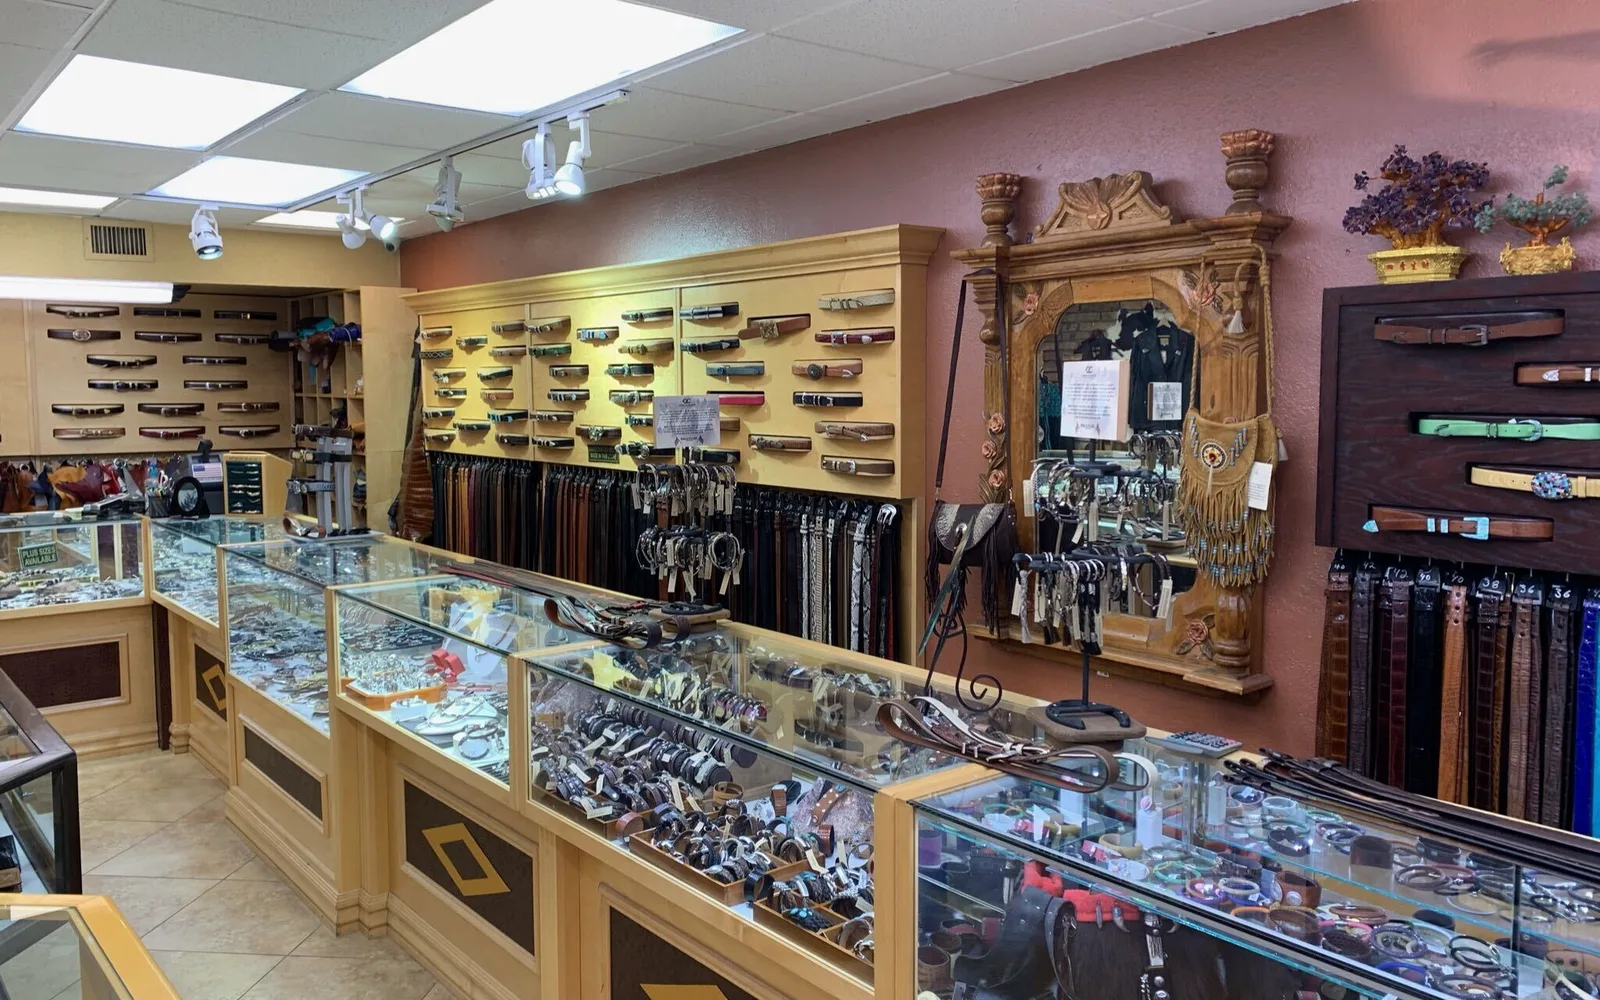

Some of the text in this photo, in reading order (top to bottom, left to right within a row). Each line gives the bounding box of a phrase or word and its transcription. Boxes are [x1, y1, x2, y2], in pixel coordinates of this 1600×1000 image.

[22, 546, 56, 558] PLUS SIZES
[24, 554, 56, 566] AVAILABLE
[1363, 561, 1376, 570] 42
[1393, 567, 1408, 579] 42
[1482, 577, 1500, 589] 38
[1519, 584, 1535, 594] 36
[1554, 588, 1572, 598] 36
